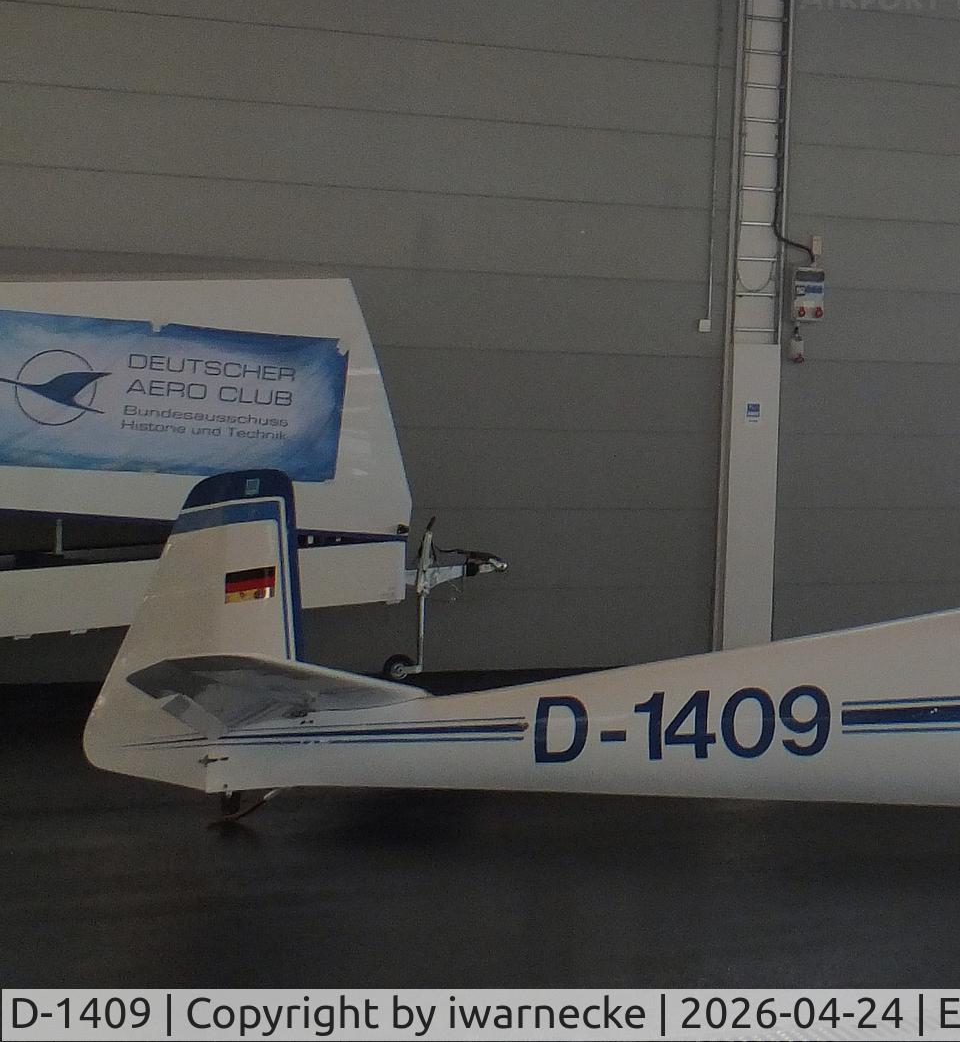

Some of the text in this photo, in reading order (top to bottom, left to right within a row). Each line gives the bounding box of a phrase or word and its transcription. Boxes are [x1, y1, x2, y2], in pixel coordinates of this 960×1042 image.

[128, 353, 296, 382] DEUTSCHER
[126, 378, 293, 407] AERO CLUB
[120, 419, 288, 440] Historie und Technik
[123, 404, 289, 427] Bundesausschuss
[533, 684, 832, 765] D-1409
